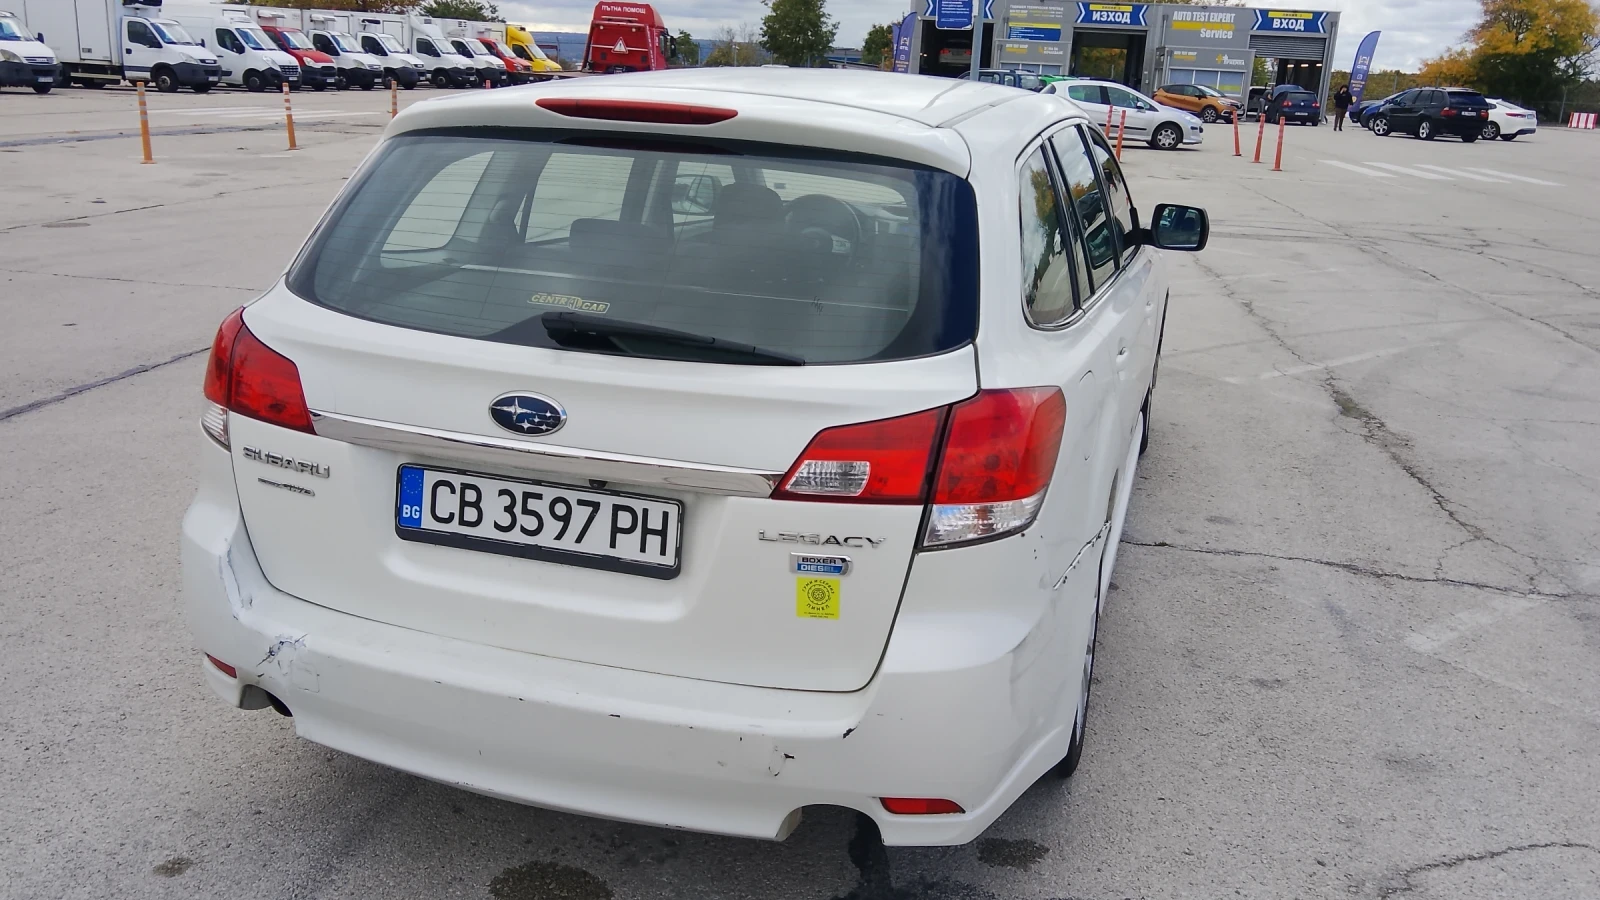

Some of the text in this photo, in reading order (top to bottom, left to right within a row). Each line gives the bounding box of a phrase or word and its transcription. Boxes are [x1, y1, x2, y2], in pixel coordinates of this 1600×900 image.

[622, 6, 646, 14] ПОМОЩ
[1092, 11, 1131, 24] ИЗХОД
[1173, 11, 1236, 23] AUTO TEST EXPERT
[1272, 18, 1305, 31] ВХОД
[1200, 28, 1233, 39] Service
[582, 302, 607, 312] CAR
[243, 445, 330, 479] SUBARU
[402, 504, 420, 519] BG
[430, 479, 669, 557] CB 3597 PH
[758, 529, 886, 549] LEGACY
[801, 557, 837, 565] BOXER
[800, 564, 839, 573] DIESEL
